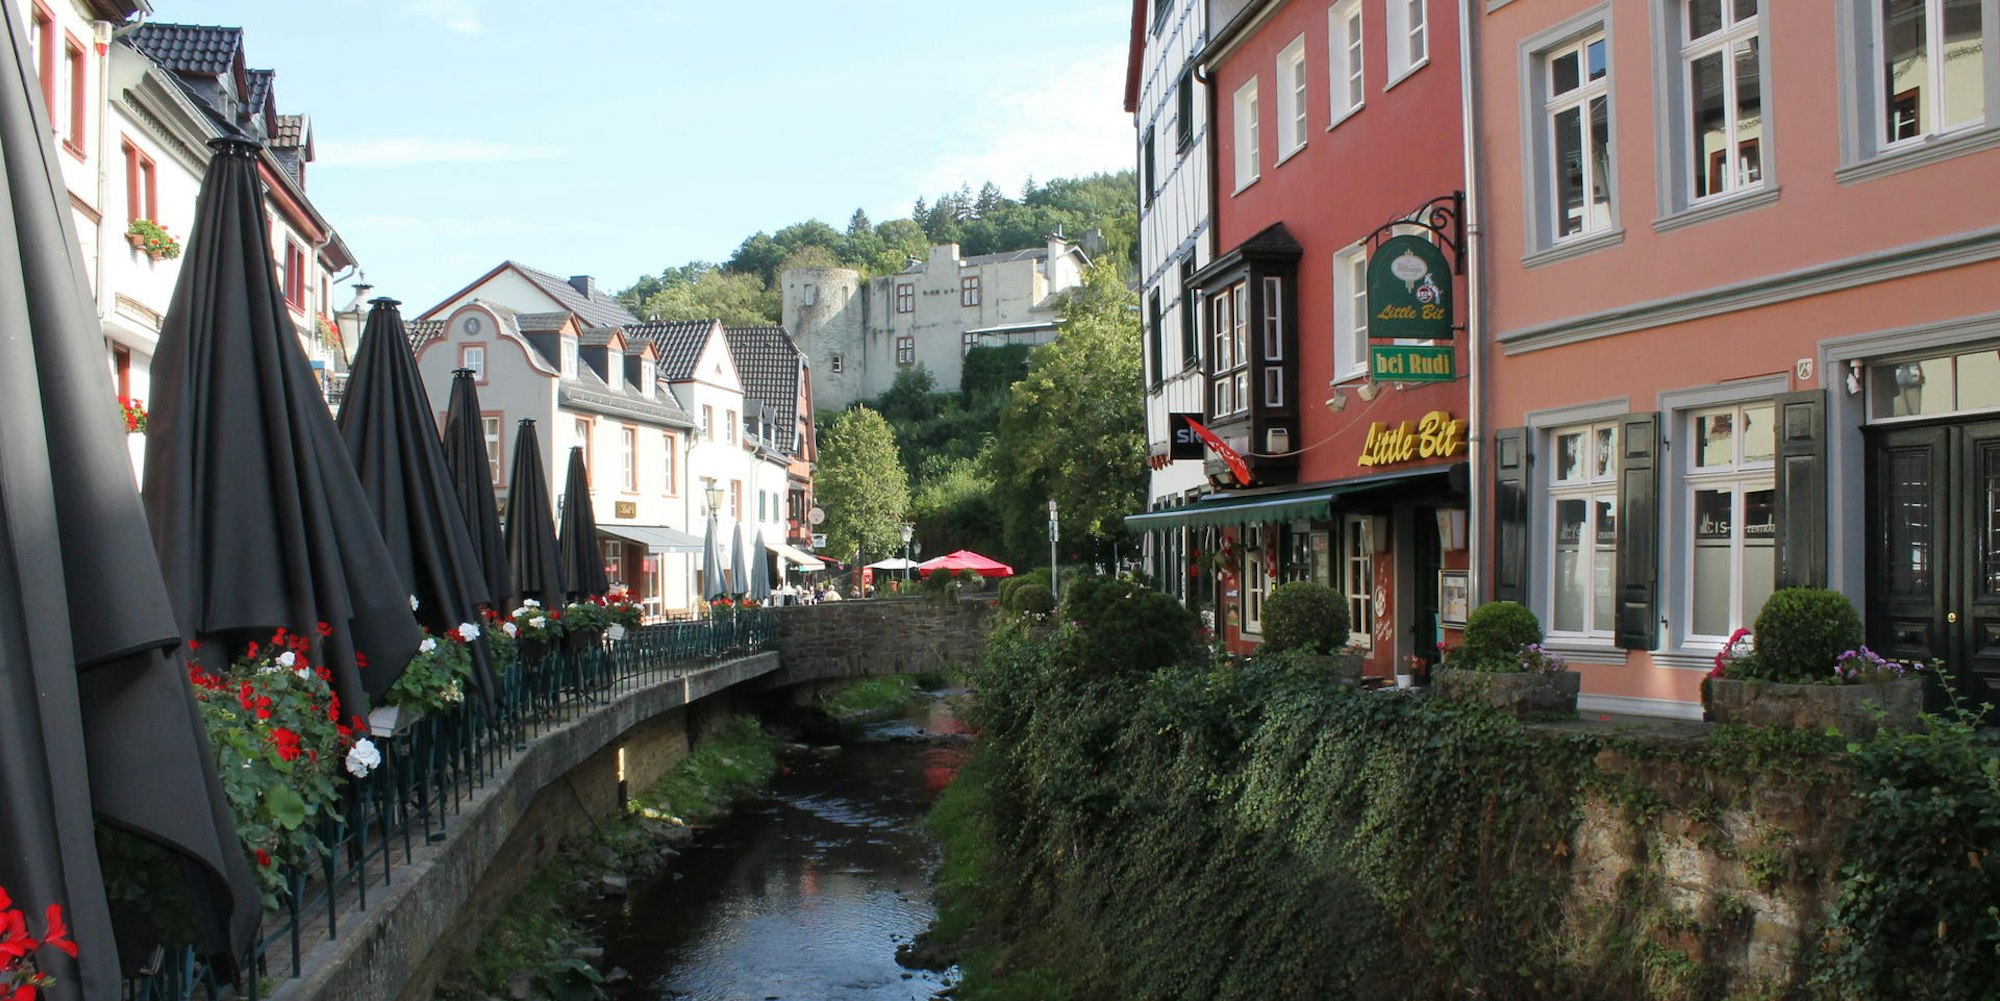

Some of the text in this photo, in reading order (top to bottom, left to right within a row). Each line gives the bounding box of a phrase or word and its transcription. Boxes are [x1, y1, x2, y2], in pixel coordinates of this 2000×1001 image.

[1377, 304, 1445, 320] Little Bit
[1376, 353, 1450, 375] bei Rudi
[1176, 426, 1203, 444] sk
[1358, 410, 1458, 467] Little Bit
[1706, 521, 1728, 534] CIS
